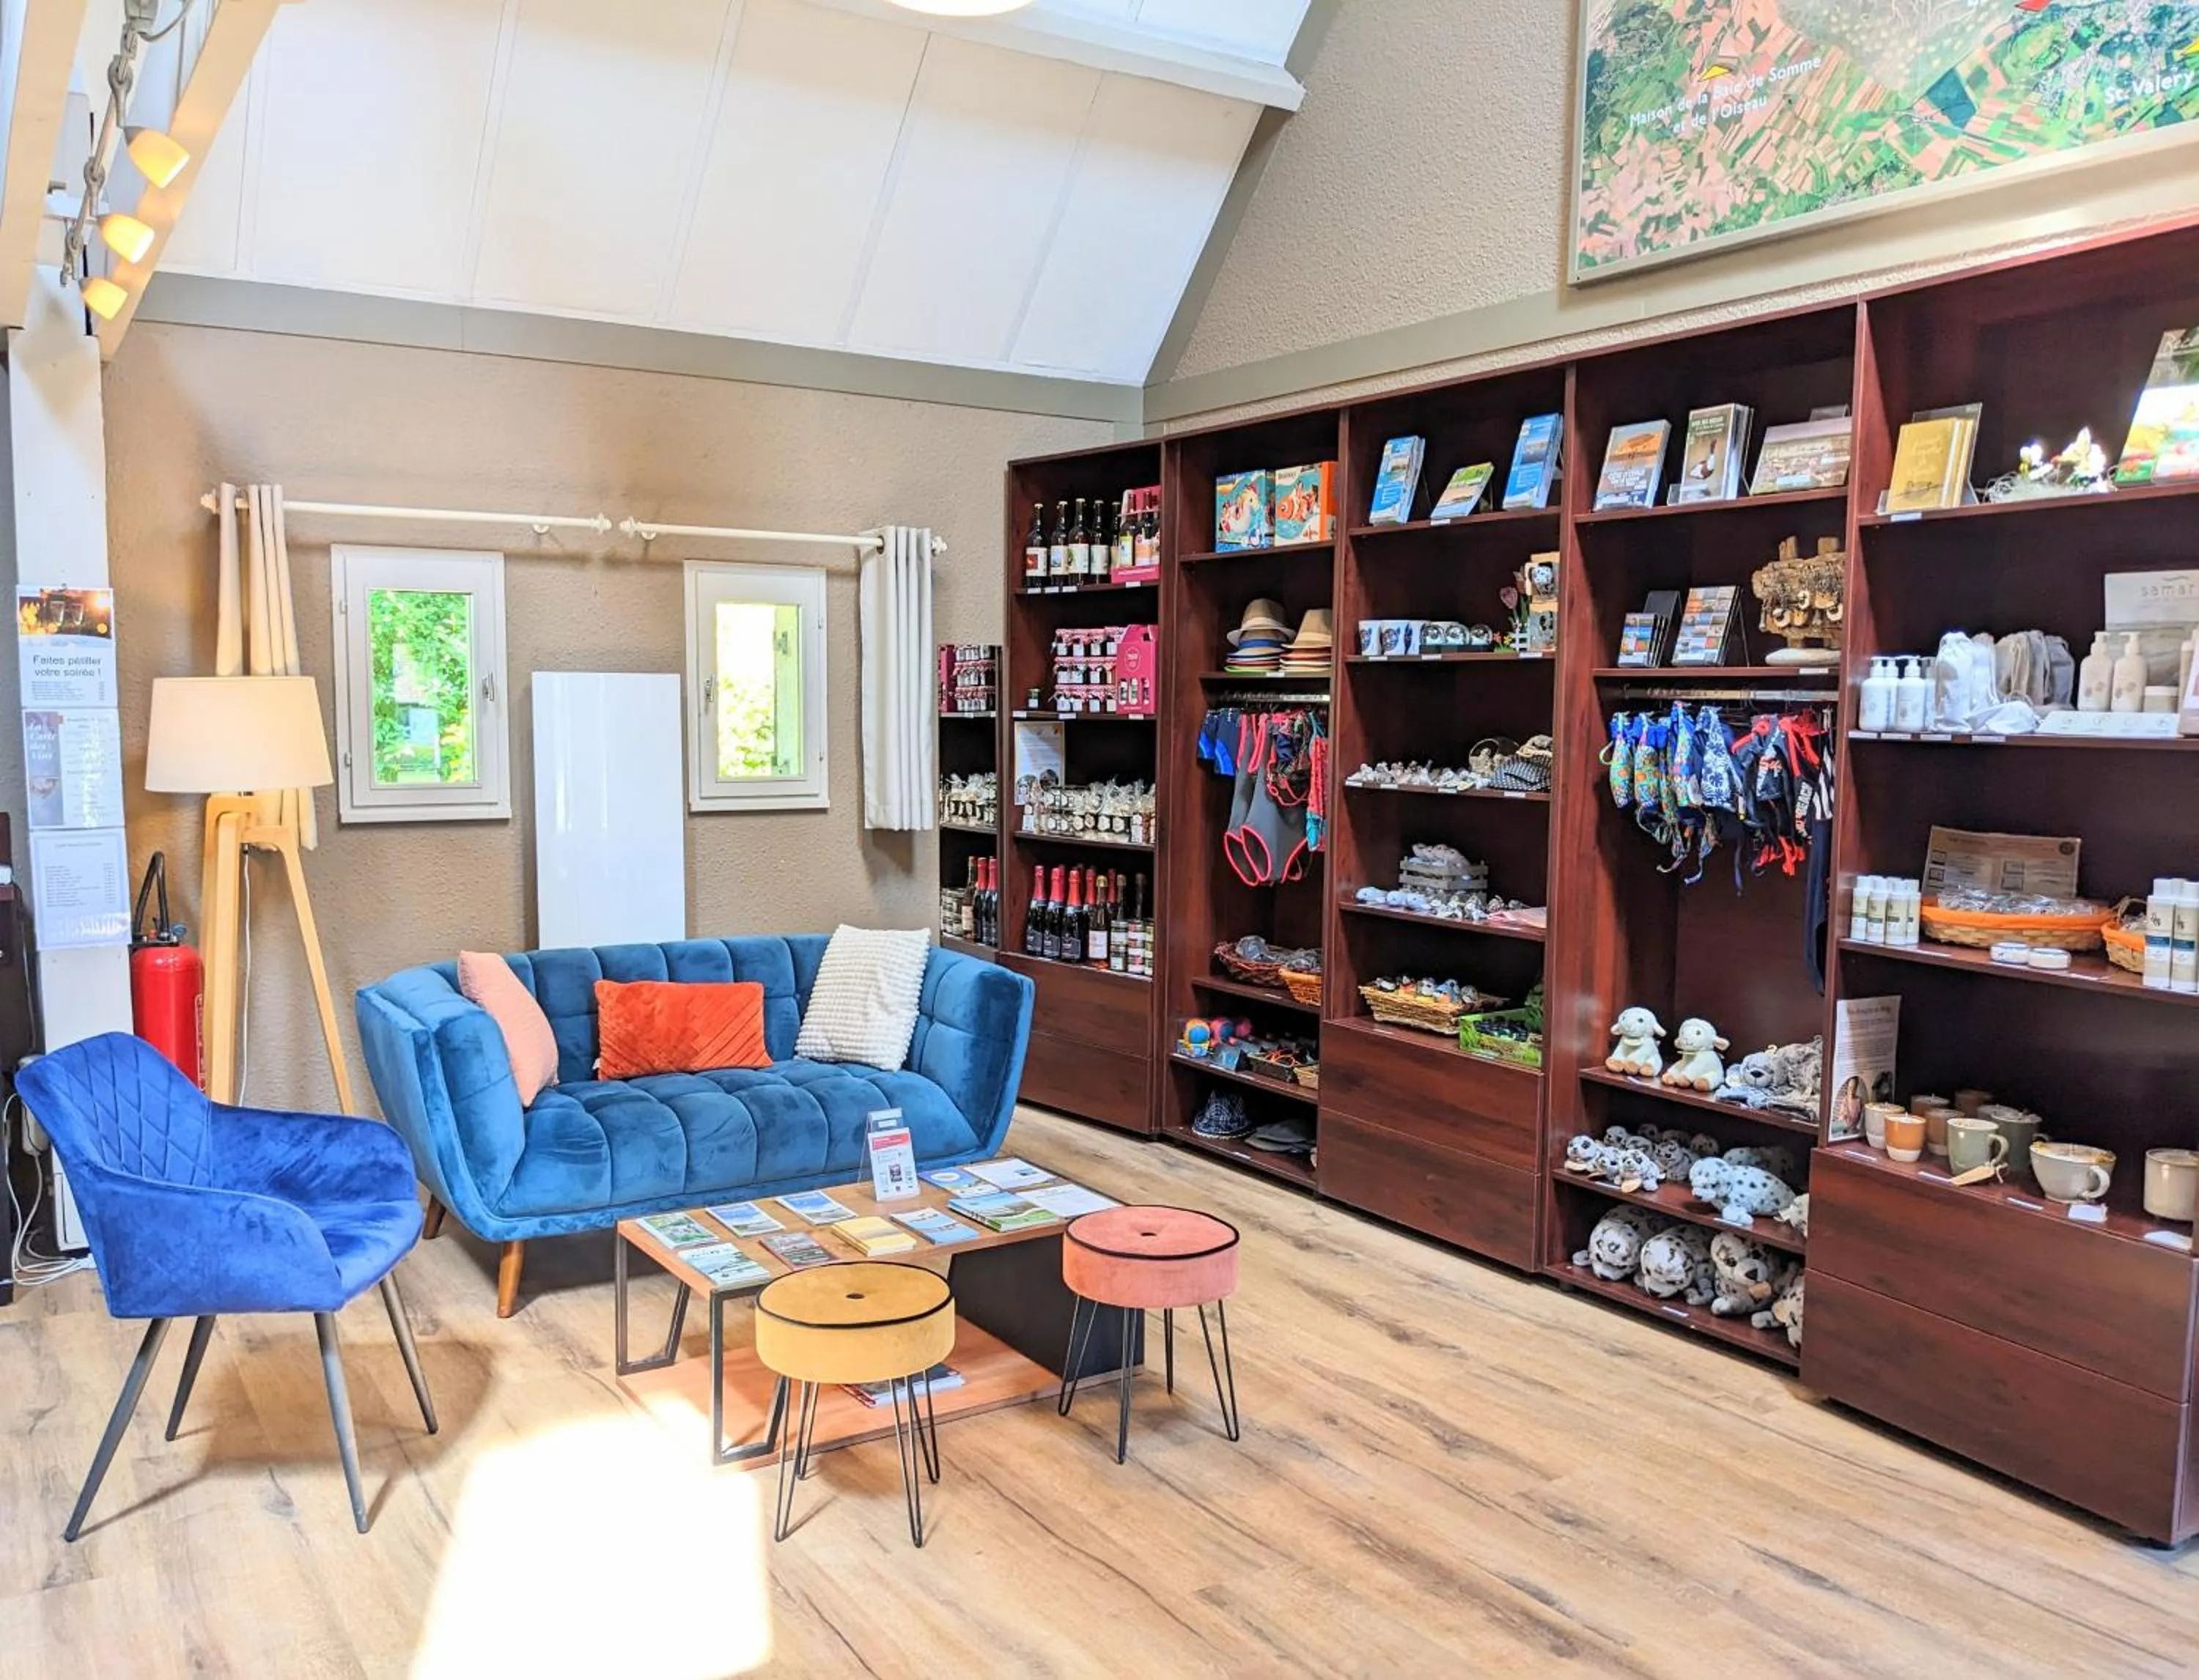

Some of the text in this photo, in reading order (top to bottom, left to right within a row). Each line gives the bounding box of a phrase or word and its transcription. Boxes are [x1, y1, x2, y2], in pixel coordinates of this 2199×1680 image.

[1629, 56, 1822, 128] Maison de la Baie de Somme
[2132, 70, 2195, 96] Valery
[1672, 95, 1767, 133] et de l'Oiseau
[33, 655, 65, 666] Faites
[34, 667, 60, 677] votre
